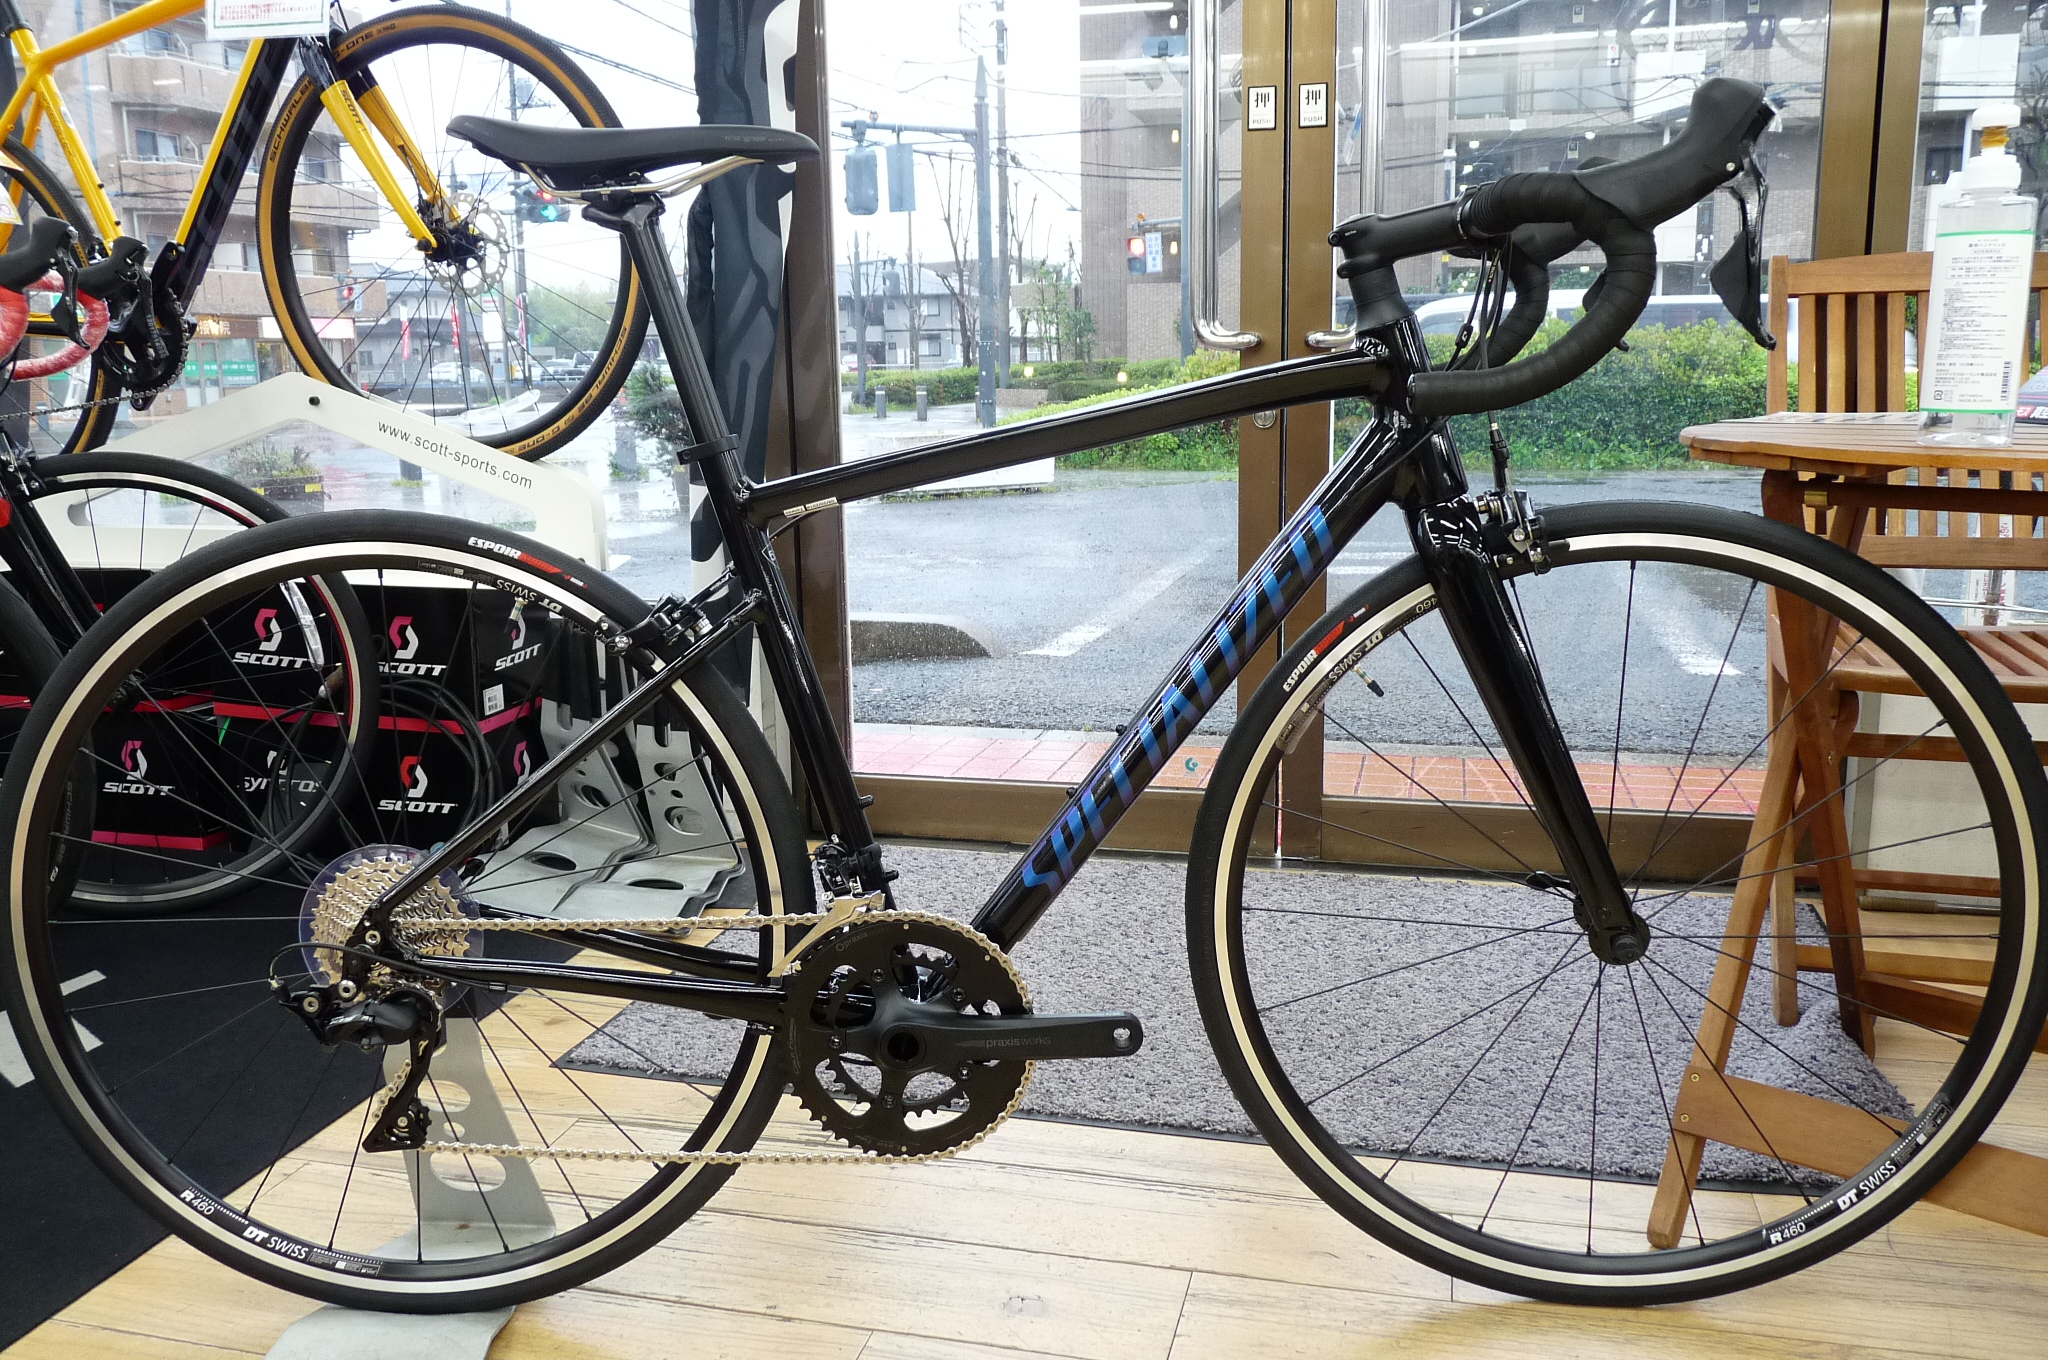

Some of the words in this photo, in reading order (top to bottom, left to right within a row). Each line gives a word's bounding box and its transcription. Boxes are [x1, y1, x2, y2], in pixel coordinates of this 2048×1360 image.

[341, 89, 363, 126] SCOTT
[1304, 89, 1321, 106] 押
[269, 77, 315, 164] SCHWALB
[378, 421, 532, 489] www.scott-sports.com
[468, 536, 522, 560] ESPOIR
[496, 579, 538, 601] SWISS
[539, 598, 562, 613] DT
[1365, 630, 1384, 651] DT
[232, 651, 308, 669] SCOTT
[494, 643, 542, 671] SCOTT
[1328, 651, 1362, 682] SWISS
[1283, 649, 1318, 692] ESPOIR
[102, 781, 173, 796] SCOTT
[377, 799, 456, 814] SCOTT
[985, 1034, 1051, 1049] praxisworks
[1836, 1189, 1859, 1211] DT
[1858, 1160, 1897, 1195] SWISS
[243, 1225, 269, 1243] DT
[267, 1236, 309, 1260] SWISS
